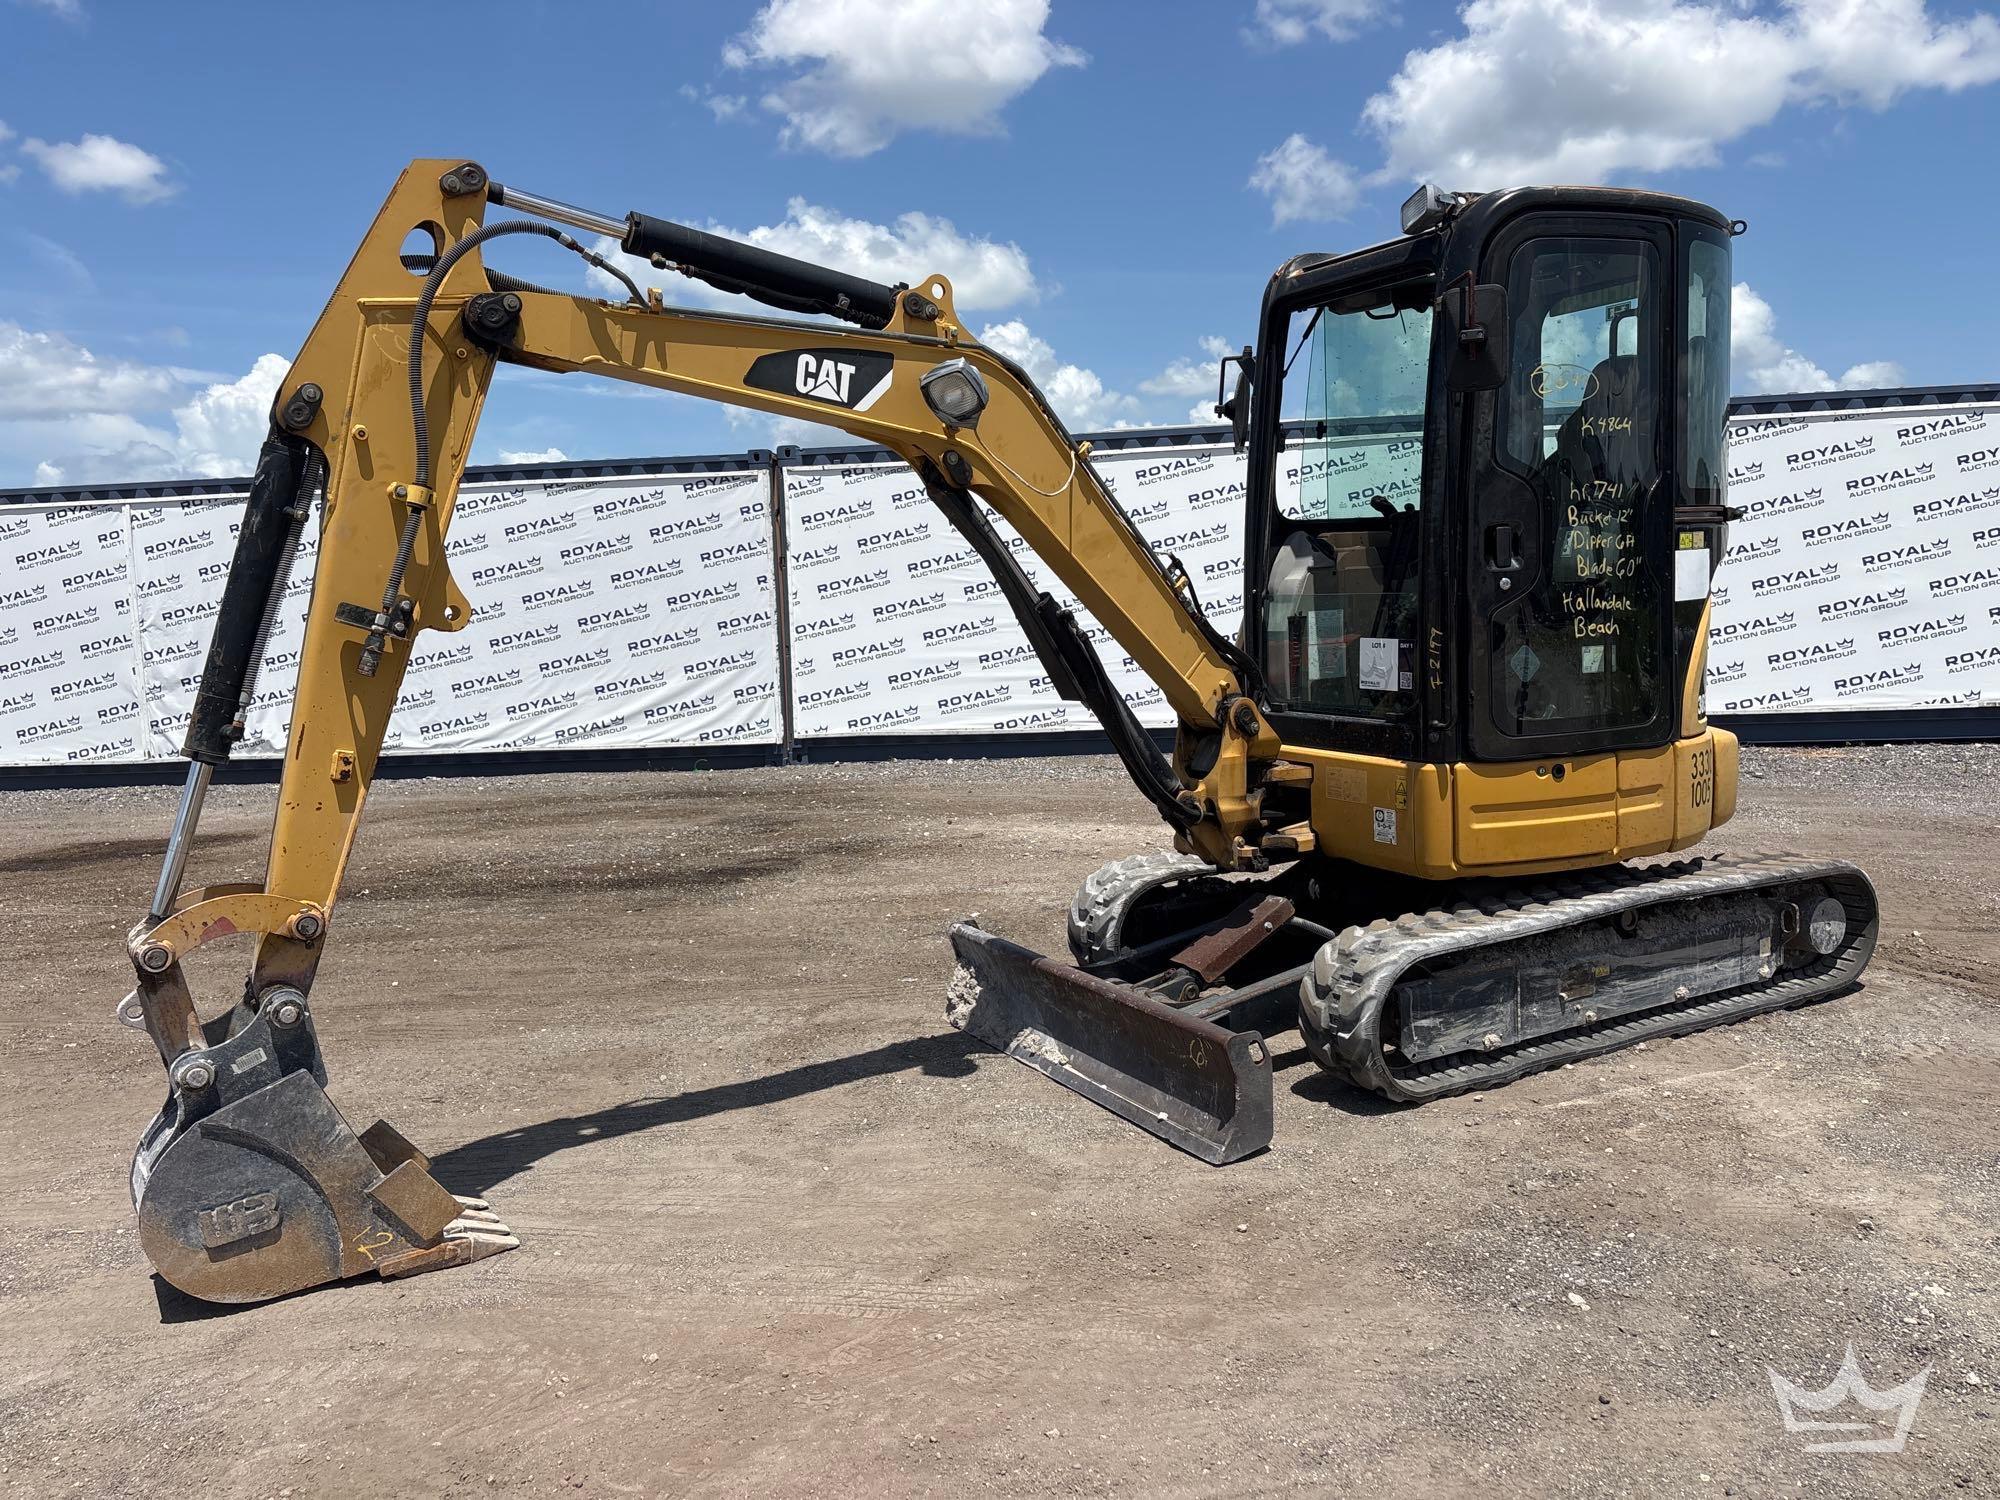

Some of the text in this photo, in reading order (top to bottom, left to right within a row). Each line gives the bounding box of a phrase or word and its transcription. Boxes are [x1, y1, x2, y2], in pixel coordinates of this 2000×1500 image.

[796, 353, 855, 403] CAT
[1897, 417, 1966, 439] ROYAL
[1900, 423, 1986, 447] AUCTION GROUP
[1787, 442, 1856, 464] ROYAL
[1790, 448, 1876, 472] AUCTION GROUP
[1135, 459, 1196, 479] ROYAL
[1138, 463, 1214, 485] AUCTION GROUP
[1286, 457, 1350, 479] ROYAL
[1290, 462, 1368, 486] AUCTION GROUP
[1846, 468, 1916, 490] ROYAL
[1849, 474, 1935, 498] AUCTION GROUP
[456, 494, 511, 513] ROYAL
[460, 498, 528, 519] AUCTION GROUP
[593, 495, 650, 514] ROYAL
[596, 500, 667, 521] AUCTION GROUP
[801, 505, 858, 525] ROYAL
[804, 511, 875, 532] AUCTION GROUP
[1567, 505, 1612, 528] Bucket
[504, 517, 560, 536] ROYAL
[508, 522, 577, 543] AUCTION GROUP
[650, 518, 706, 538] ROYAL
[653, 523, 723, 544] AUCTION GROUP
[1802, 518, 1872, 540] ROYAL
[1805, 524, 1892, 548] AUCTION GROUP
[144, 535, 198, 555] ROYAL
[857, 528, 914, 548] ROYAL
[860, 534, 931, 555] AUCTION GROUP
[16, 545, 67, 564] ROYAL
[147, 541, 214, 562] AUCTION GROUP
[560, 540, 616, 559] ROYAL
[563, 545, 633, 566] AUCTION GROUP
[1862, 544, 1932, 566] ROYAL
[19, 550, 82, 571] AUCTION GROUP
[472, 561, 527, 580] ROYAL
[908, 553, 964, 572] ROYAL
[911, 559, 981, 579] AUCTION GROUP
[1577, 554, 1613, 576] Blade
[1865, 550, 1951, 574] AUCTION GROUP
[475, 567, 544, 587] AUCTION GROUP
[611, 564, 667, 583] ROYAL
[614, 570, 684, 590] AUCTION GROUP
[817, 574, 874, 593] ROYAL
[1752, 568, 1820, 590] ROYAL
[522, 585, 578, 604] ROYAL
[667, 587, 723, 606] ROYAL
[820, 580, 891, 600] AUCTION GROUP
[1755, 575, 1840, 598] AUCTION GROUP
[525, 591, 594, 611] AUCTION GROUP
[670, 592, 740, 613] AUCTION GROUP
[873, 597, 930, 616] ROYAL
[1562, 587, 1632, 613] Hallandale
[1818, 593, 1888, 614] ROYAL
[33, 611, 84, 630] ROYAL
[577, 608, 634, 627] ROYAL
[876, 603, 947, 623] AUCTION GROUP
[1821, 600, 1908, 622] AUCTION GROUP
[36, 617, 100, 637] AUCTION GROUP
[580, 614, 650, 634] AUCTION GROUP
[923, 621, 980, 640] ROYAL
[1574, 615, 1619, 639] Beach
[1709, 617, 1777, 638] ROYAL
[1878, 620, 1948, 641] ROYAL
[489, 629, 545, 648] ROYAL
[492, 634, 561, 655] AUCTION GROUP
[628, 632, 684, 651] ROYAL
[925, 627, 997, 648] AUCTION GROUP
[1712, 623, 1796, 646] AUCTION GROUP
[1882, 626, 1967, 649] AUCTION GROUP
[630, 638, 701, 658] AUCTION GROUP
[832, 642, 889, 661] ROYAL
[835, 648, 906, 668] AUCTION GROUP
[1768, 643, 1836, 664] ROYAL
[684, 655, 740, 674] ROYAL
[686, 661, 757, 681] AUCTION GROUP
[1771, 650, 1856, 672] AUCTION GROUP
[451, 674, 507, 692] ROYAL
[888, 665, 945, 684] ROYAL
[890, 671, 962, 691] AUCTION GROUP
[1834, 668, 1904, 689] ROYAL
[51, 677, 102, 695] ROYAL
[54, 682, 117, 702] AUCTION GROUP
[454, 679, 523, 699] AUCTION GROUP
[798, 686, 854, 704] ROYAL
[1837, 675, 1924, 697] AUCTION GROUP
[801, 691, 871, 711] AUCTION GROUP
[938, 690, 995, 708] ROYAL
[940, 695, 1012, 715] AUCTION GROUP
[16, 720, 67, 738] ROYAL
[19, 726, 83, 745] AUCTION GROUP
